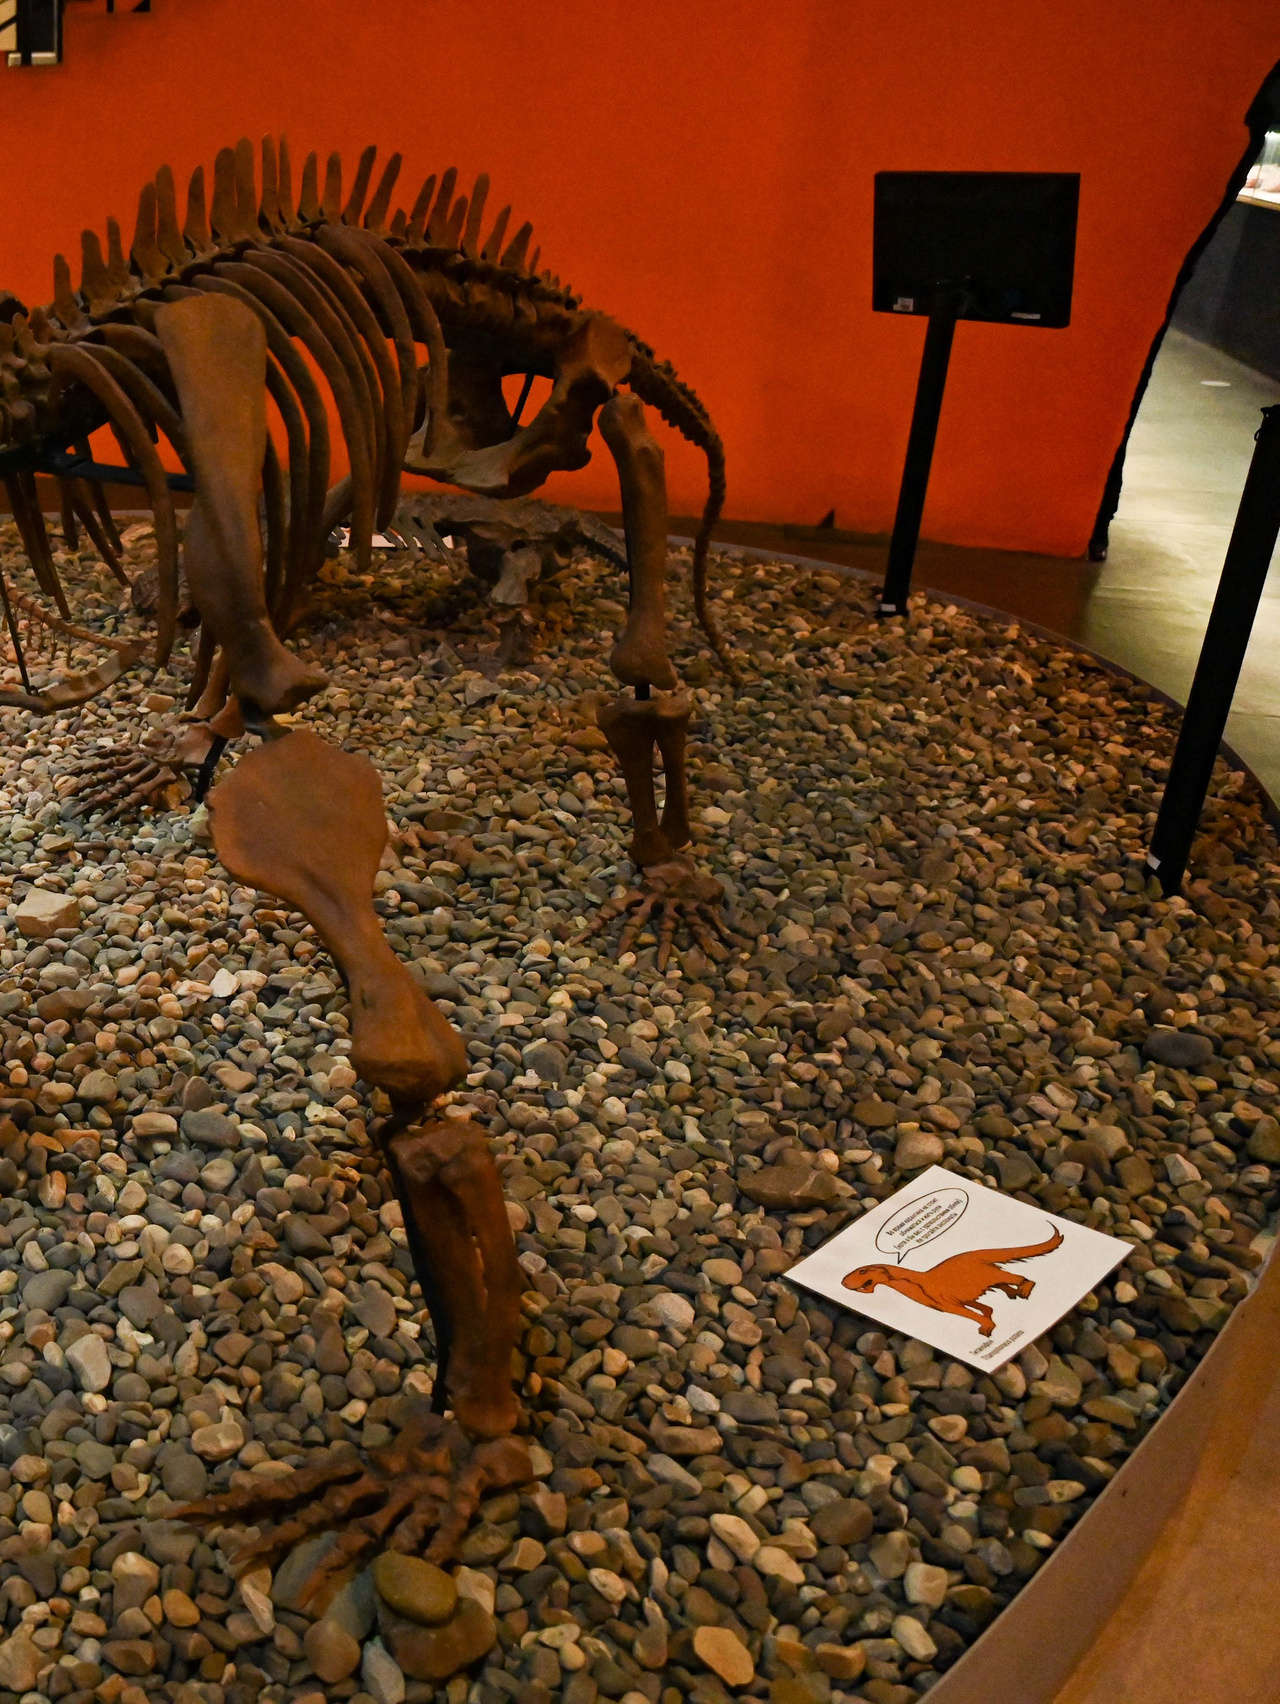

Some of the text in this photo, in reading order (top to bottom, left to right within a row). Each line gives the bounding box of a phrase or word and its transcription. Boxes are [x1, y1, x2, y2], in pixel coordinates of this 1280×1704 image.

[892, 1222, 905, 1232] время
[904, 1209, 924, 1223] карантина
[926, 1198, 938, 1207] стоит
[893, 1240, 907, 1250] (хотя
[922, 1209, 950, 1229] удовольствием
[948, 1198, 963, 1210] обнял)
[899, 1219, 922, 1236] обниматься
[931, 1205, 942, 1213] руки
[921, 1226, 940, 1239] трогайте
[937, 1213, 958, 1228] экспонаты
